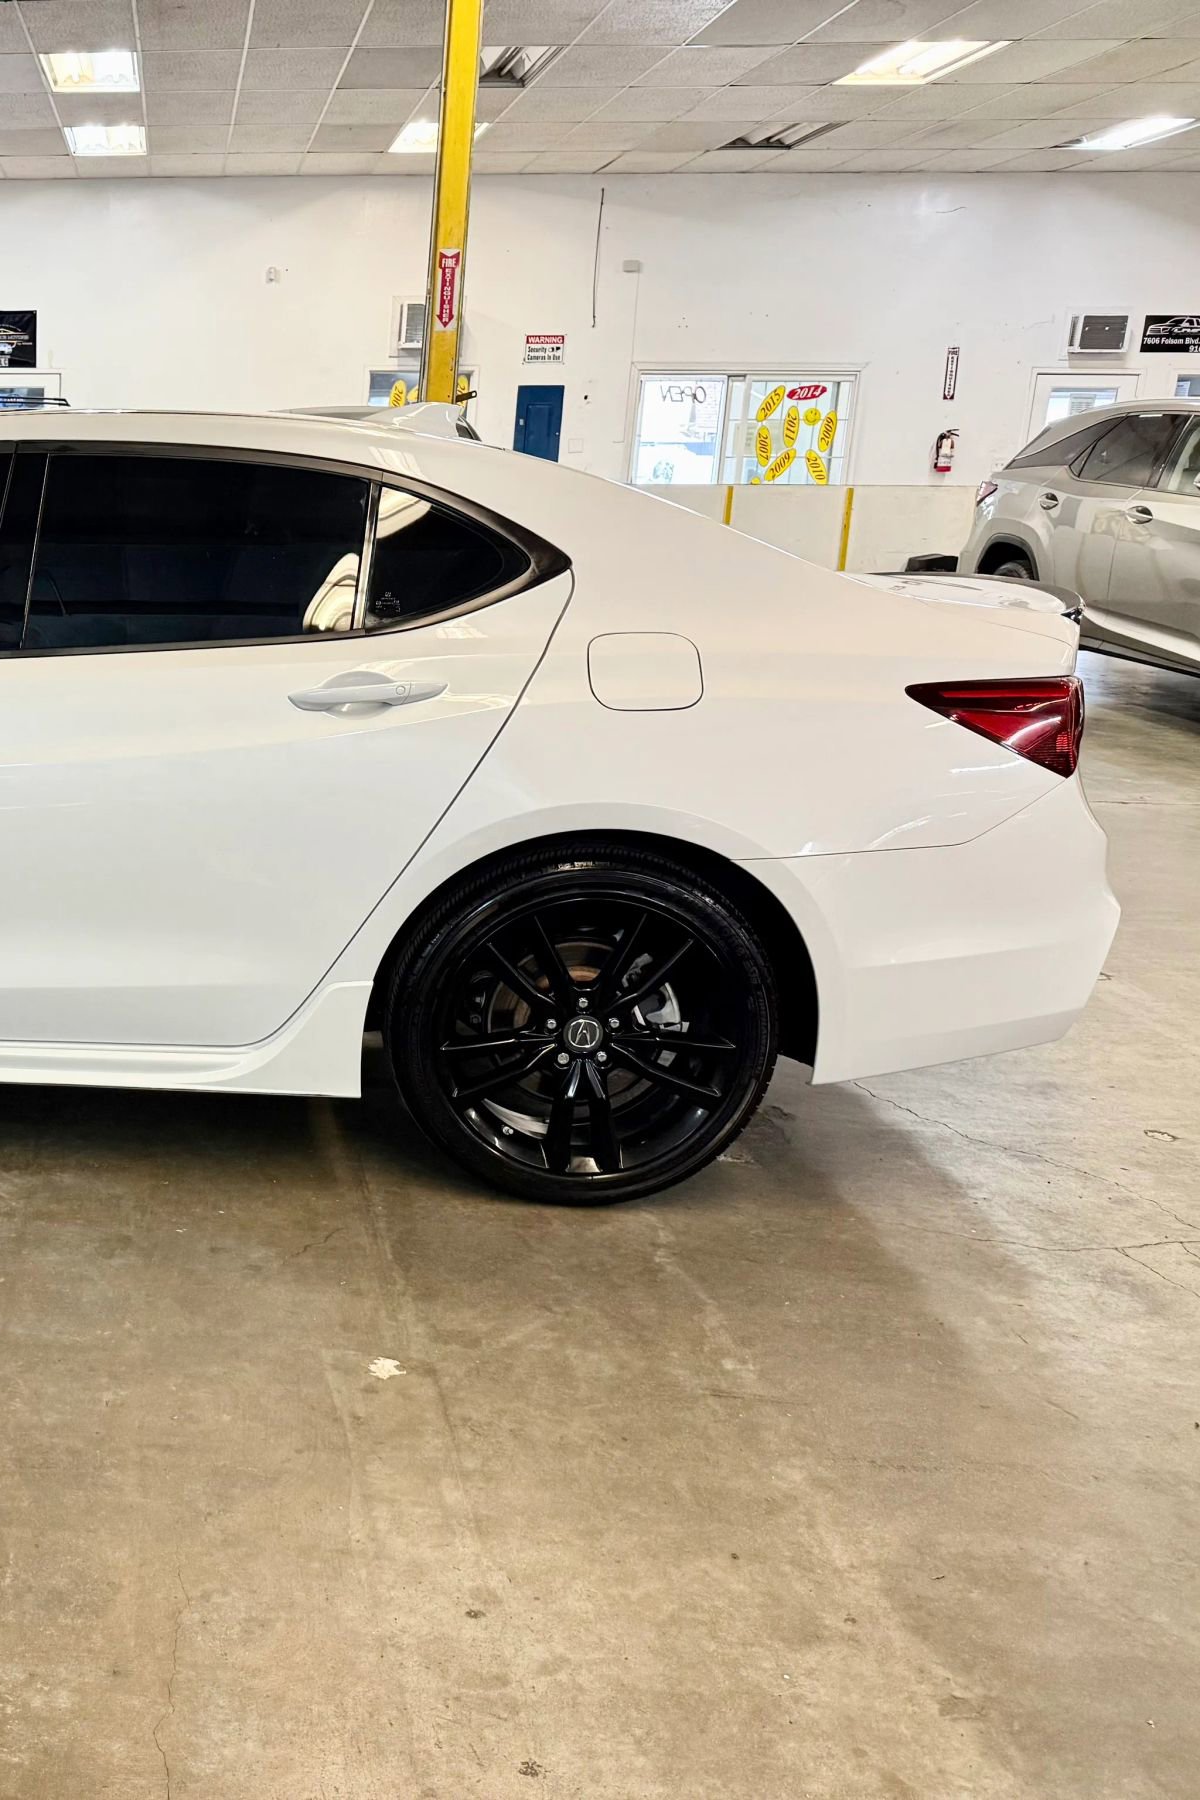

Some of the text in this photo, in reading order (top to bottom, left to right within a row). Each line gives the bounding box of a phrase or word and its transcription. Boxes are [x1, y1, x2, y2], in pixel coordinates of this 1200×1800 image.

[442, 258, 456, 268] FIRE
[443, 268, 452, 322] EXTINGUISHER
[528, 336, 562, 344] WARNING
[528, 346, 547, 354] Security
[391, 386, 403, 407] 200
[761, 390, 781, 418] 2015
[793, 386, 823, 400] 2014
[786, 413, 797, 440] 2011
[821, 416, 834, 447] 2009
[759, 433, 768, 460] 2007
[770, 452, 791, 478] 2009
[807, 456, 825, 480] 2010
